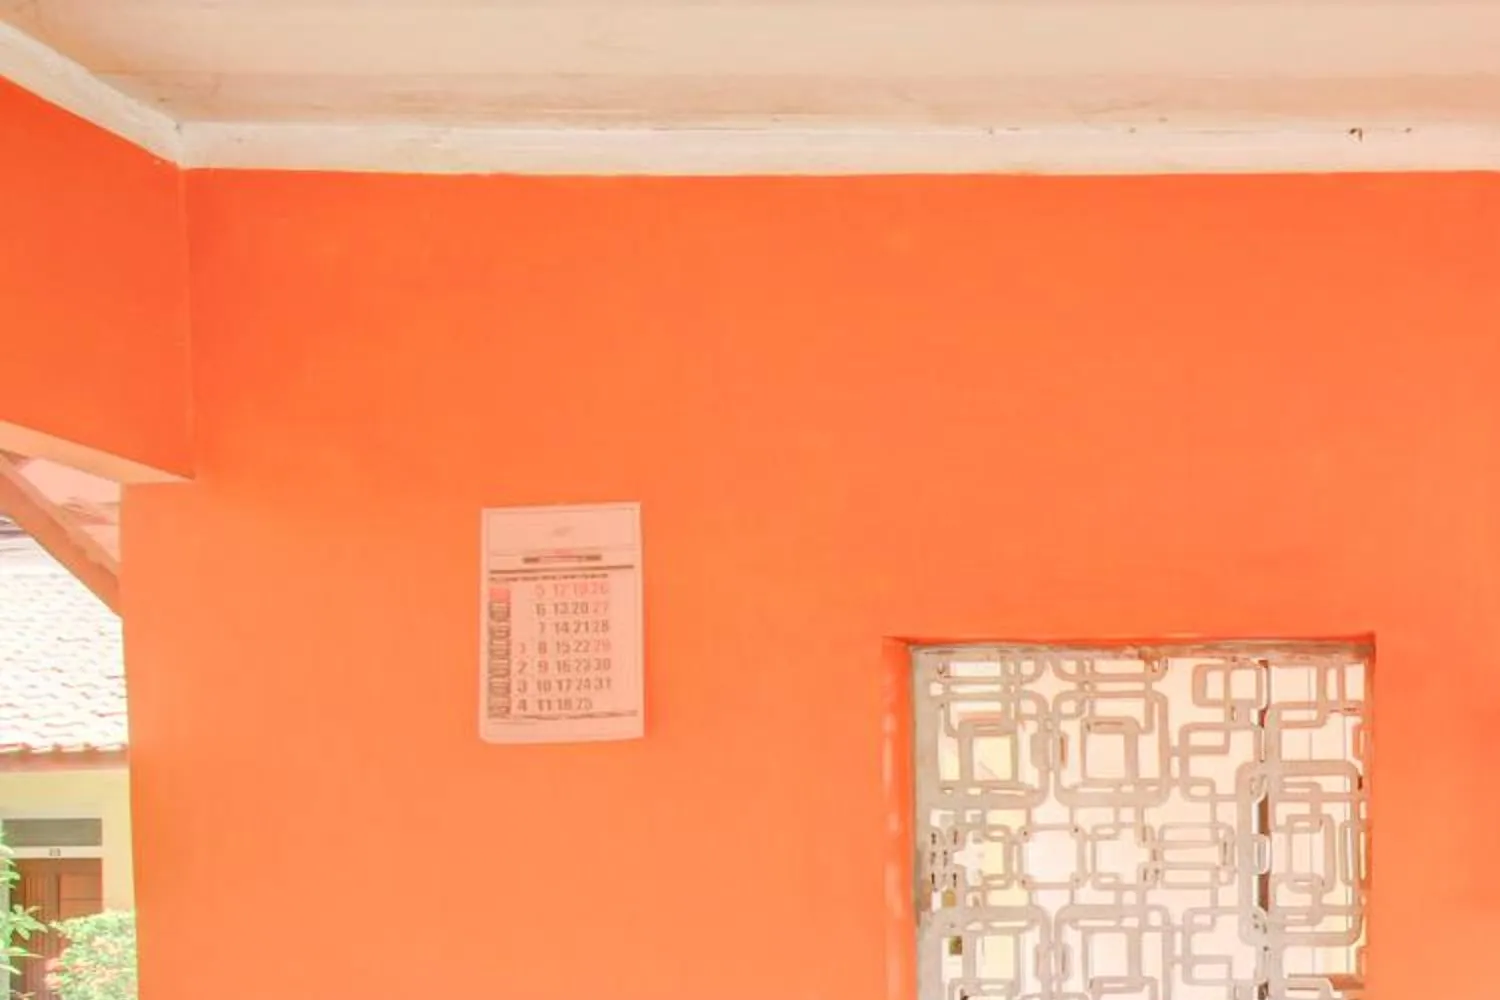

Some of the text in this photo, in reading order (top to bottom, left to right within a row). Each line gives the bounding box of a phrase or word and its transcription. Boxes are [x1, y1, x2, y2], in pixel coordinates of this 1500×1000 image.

[554, 602, 569, 616] 13
[572, 601, 588, 615] 20
[554, 621, 569, 633] 14
[573, 620, 589, 633] 21
[592, 620, 610, 633] 28
[556, 641, 571, 653] 15
[574, 640, 590, 653] 22
[517, 661, 527, 674] 2
[595, 658, 611, 671] 30
[517, 677, 612, 693] 3 10 17 24 31
[517, 699, 527, 712] 4
[537, 699, 552, 712] 11
[557, 698, 572, 711] 18
